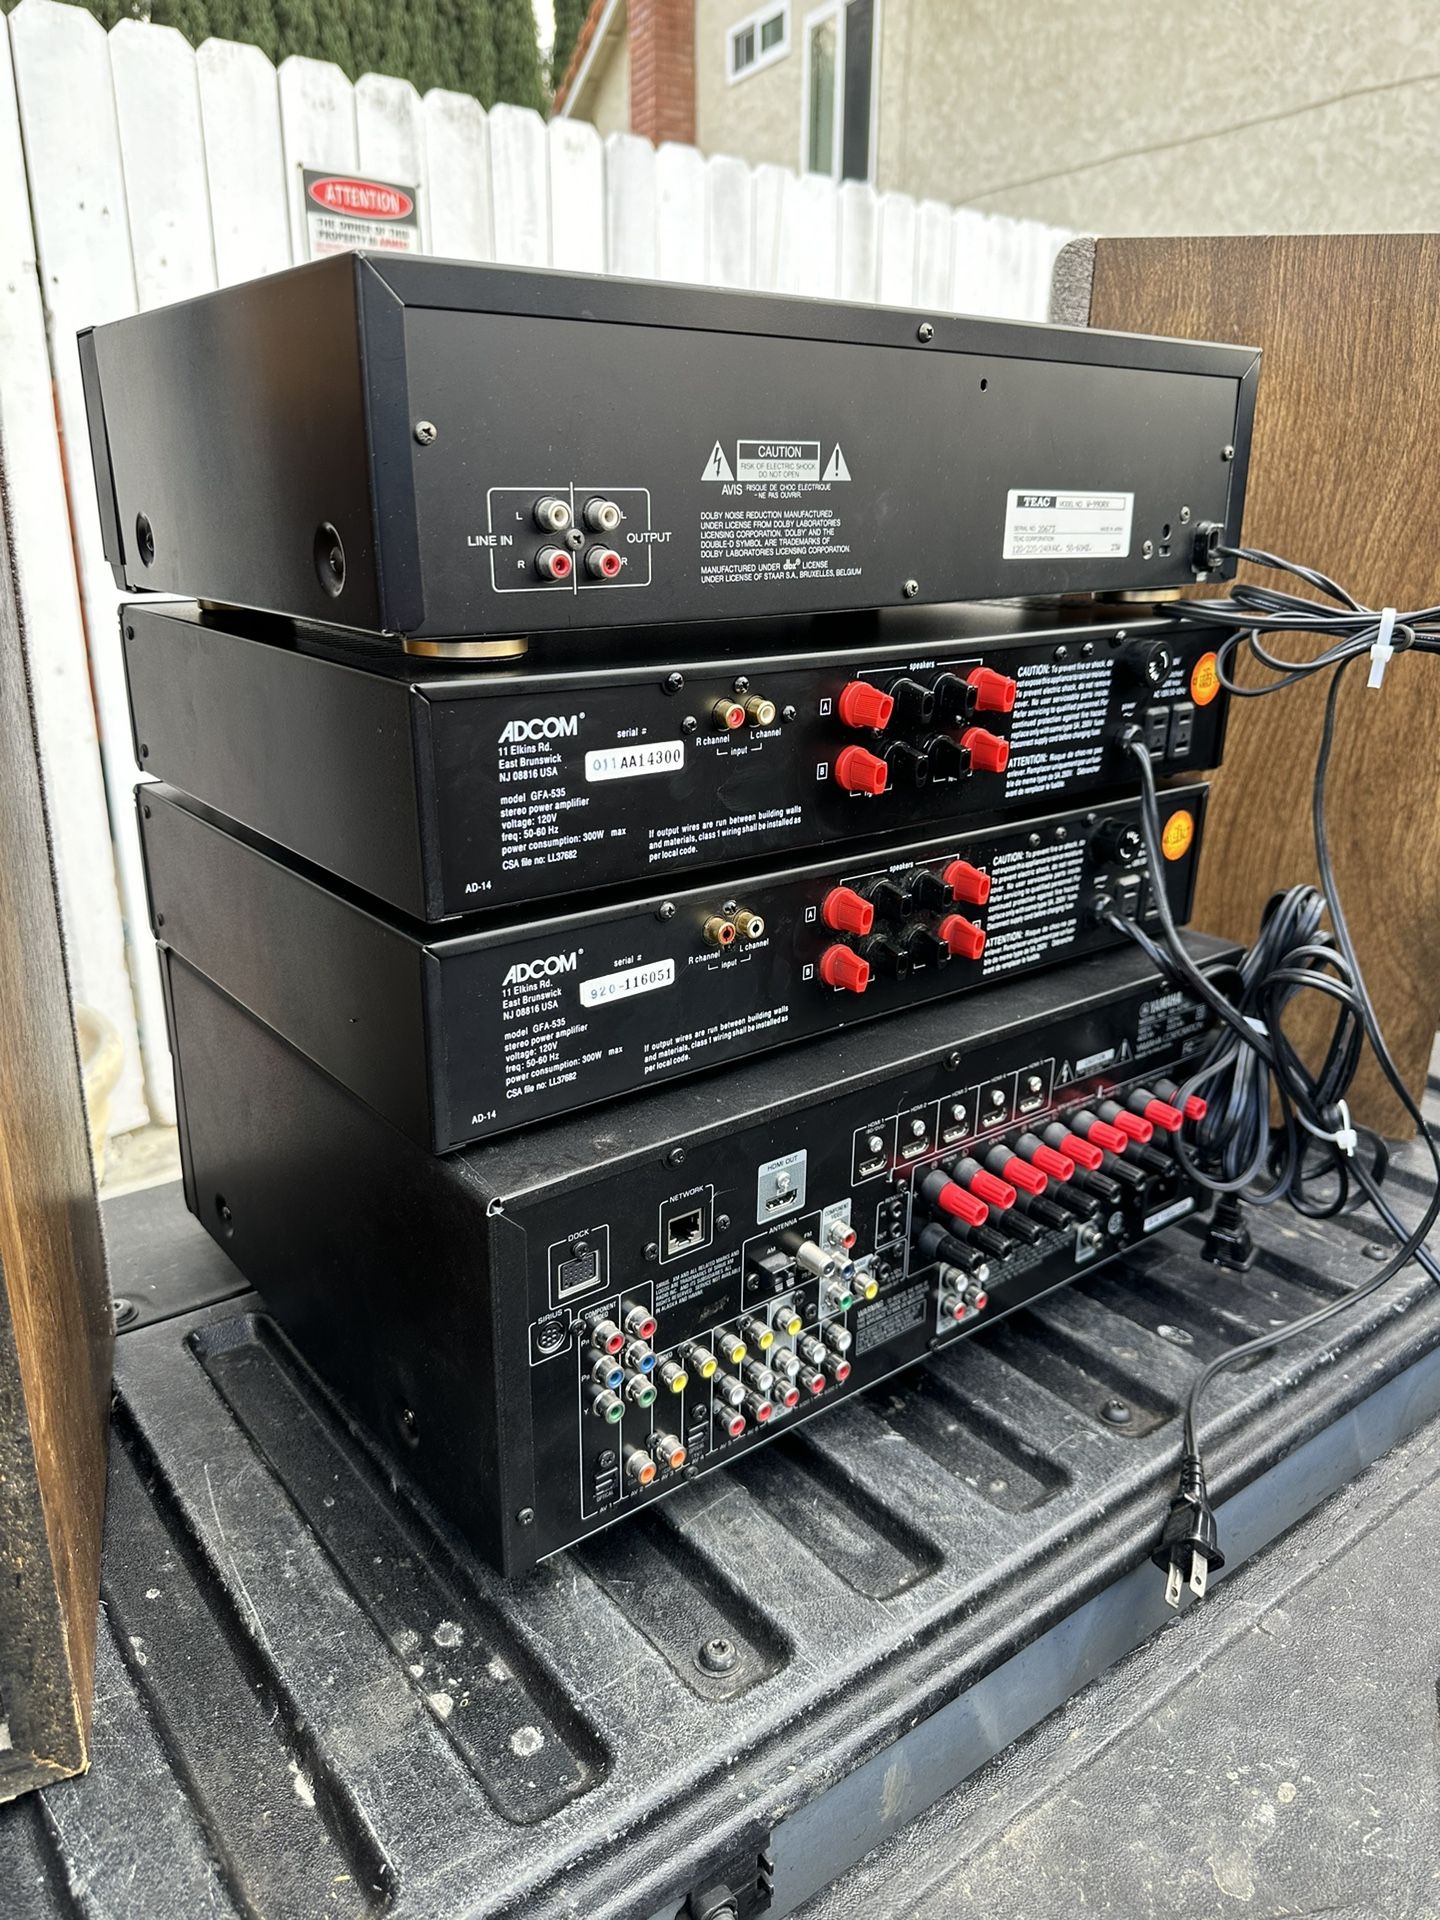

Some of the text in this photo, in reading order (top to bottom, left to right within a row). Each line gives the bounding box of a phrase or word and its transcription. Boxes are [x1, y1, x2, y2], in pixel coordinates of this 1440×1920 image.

[325, 183, 400, 215] ATTENTION
[758, 446, 801, 458] CAUTION
[722, 484, 743, 495] AVIS
[798, 483, 831, 491] ELECTRIQUE
[1023, 497, 1050, 507] TEAC
[516, 511, 523, 520] L
[701, 512, 723, 520] DOLBY
[746, 511, 782, 519] REDUCTION
[784, 510, 833, 518] MANUFACTURED
[725, 521, 751, 529] LICENSE
[796, 519, 841, 527] LABORATORIES
[467, 535, 512, 546] LINE IN
[627, 532, 672, 543] OUTPUT
[701, 531, 734, 539] LICENSING
[736, 530, 782, 538] CORPORATION.
[809, 528, 821, 536] AND
[701, 540, 734, 548] DOUBLE-D
[736, 539, 762, 547] SYMBOL
[765, 539, 777, 547] ARE
[779, 537, 820, 546] TRADEMARKS
[701, 550, 723, 558] DOLBY
[726, 548, 774, 557] LABORATORIES
[776, 547, 806, 555] LICENSING
[518, 560, 525, 568] R
[621, 557, 628, 566] R
[701, 564, 756, 574] MANUFACTURED
[803, 561, 828, 569] LICENSE
[701, 575, 724, 583] UNDER
[726, 574, 752, 582] LICENSE
[754, 573, 763, 581] OF
[764, 572, 784, 580] STAAR
[836, 568, 862, 576] BELGIUM
[910, 661, 935, 671] speakers
[498, 715, 578, 743] ADCOM
[617, 728, 638, 738] serial
[750, 728, 781, 739] L channel
[696, 735, 730, 746] R channel
[499, 742, 552, 756] 11 Elkins Rd.
[731, 746, 747, 756] input
[499, 754, 562, 769] East Brunswick
[500, 767, 558, 782] NJ 08816 USA
[500, 788, 566, 805] model GFA-535
[500, 797, 589, 818] stereo power amplifier
[502, 813, 557, 829] voltage: 120V
[649, 805, 802, 839] If output wires are run between building walls
[502, 825, 559, 843] freq: 50-60 Hz
[649, 841, 662, 850] and
[664, 835, 698, 847] materials,
[698, 831, 716, 841] class
[722, 827, 741, 837] wiring
[742, 823, 758, 832] shall
[758, 822, 765, 830] be
[767, 818, 793, 829] installed
[502, 828, 626, 856] power consumption: 300W max
[502, 850, 577, 870] CSA file no: LL37682
[649, 846, 698, 862] per local code.
[890, 861, 914, 873] speakers
[465, 881, 492, 893] AD-14
[740, 938, 769, 952] L channel
[614, 955, 634, 967] serial
[689, 950, 720, 964] R channel
[721, 959, 738, 969] input
[502, 952, 577, 986] ADCOM
[590, 968, 671, 1000] 920-116051
[504, 1018, 566, 1040] model GFA-535
[472, 1110, 496, 1124] AD-14
[767, 1155, 799, 1171] HDMI OUT
[669, 1185, 704, 1203] NETWORK
[769, 1217, 797, 1234] ANTENNA
[568, 1228, 590, 1242] DOCK
[767, 1246, 776, 1254] AM
[538, 1309, 563, 1325] SIRIUS
[585, 1301, 616, 1320] COMPONENT
[584, 1408, 589, 1416] Y
